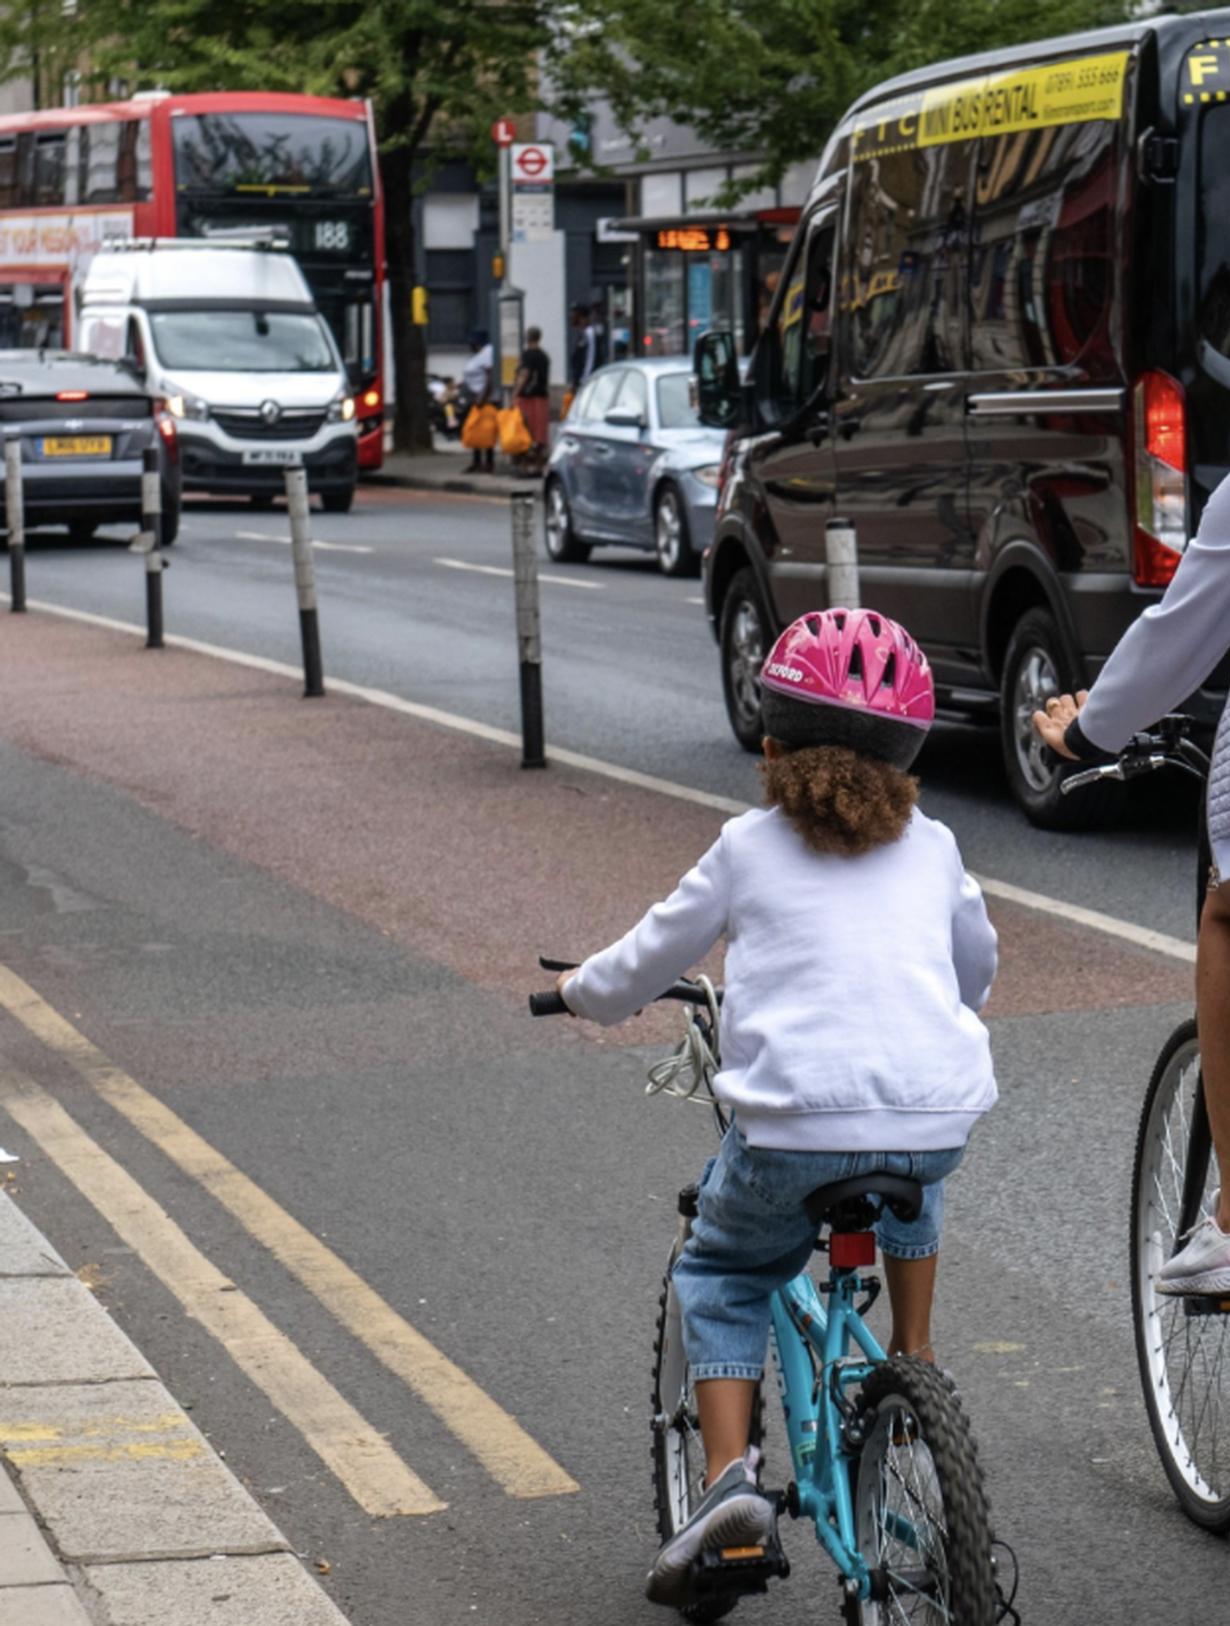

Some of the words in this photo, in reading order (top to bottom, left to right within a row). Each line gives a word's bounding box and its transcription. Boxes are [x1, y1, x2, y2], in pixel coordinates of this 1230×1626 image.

[952, 94, 979, 133] BUS
[983, 83, 1038, 126] RENTAL
[498, 122, 513, 141] L
[315, 222, 349, 248] 188
